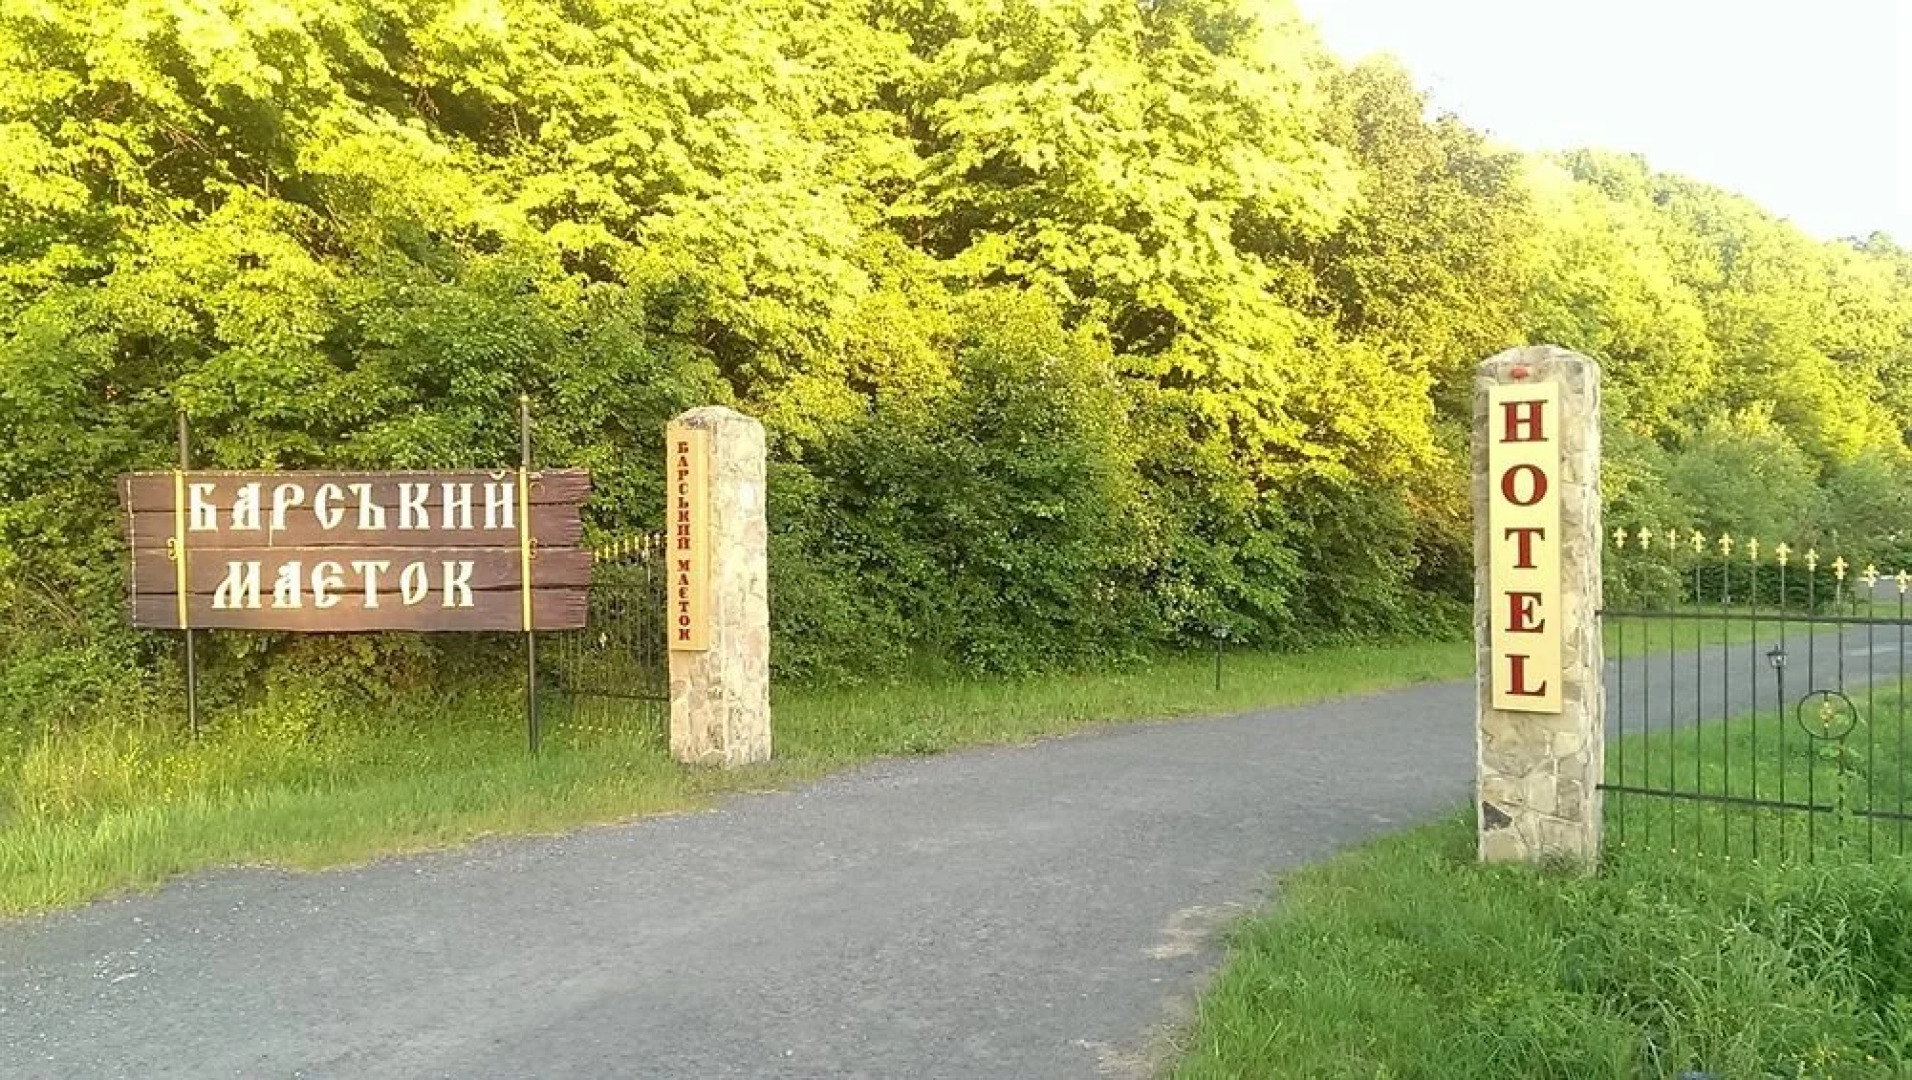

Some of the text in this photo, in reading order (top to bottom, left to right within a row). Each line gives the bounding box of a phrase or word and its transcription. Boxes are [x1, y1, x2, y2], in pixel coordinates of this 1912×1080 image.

[211, 561, 475, 609] МАЄТОК
[677, 441, 691, 641] БАРСЬКИЙ МАЄТОК
[1499, 400, 1549, 697] HOTEL
